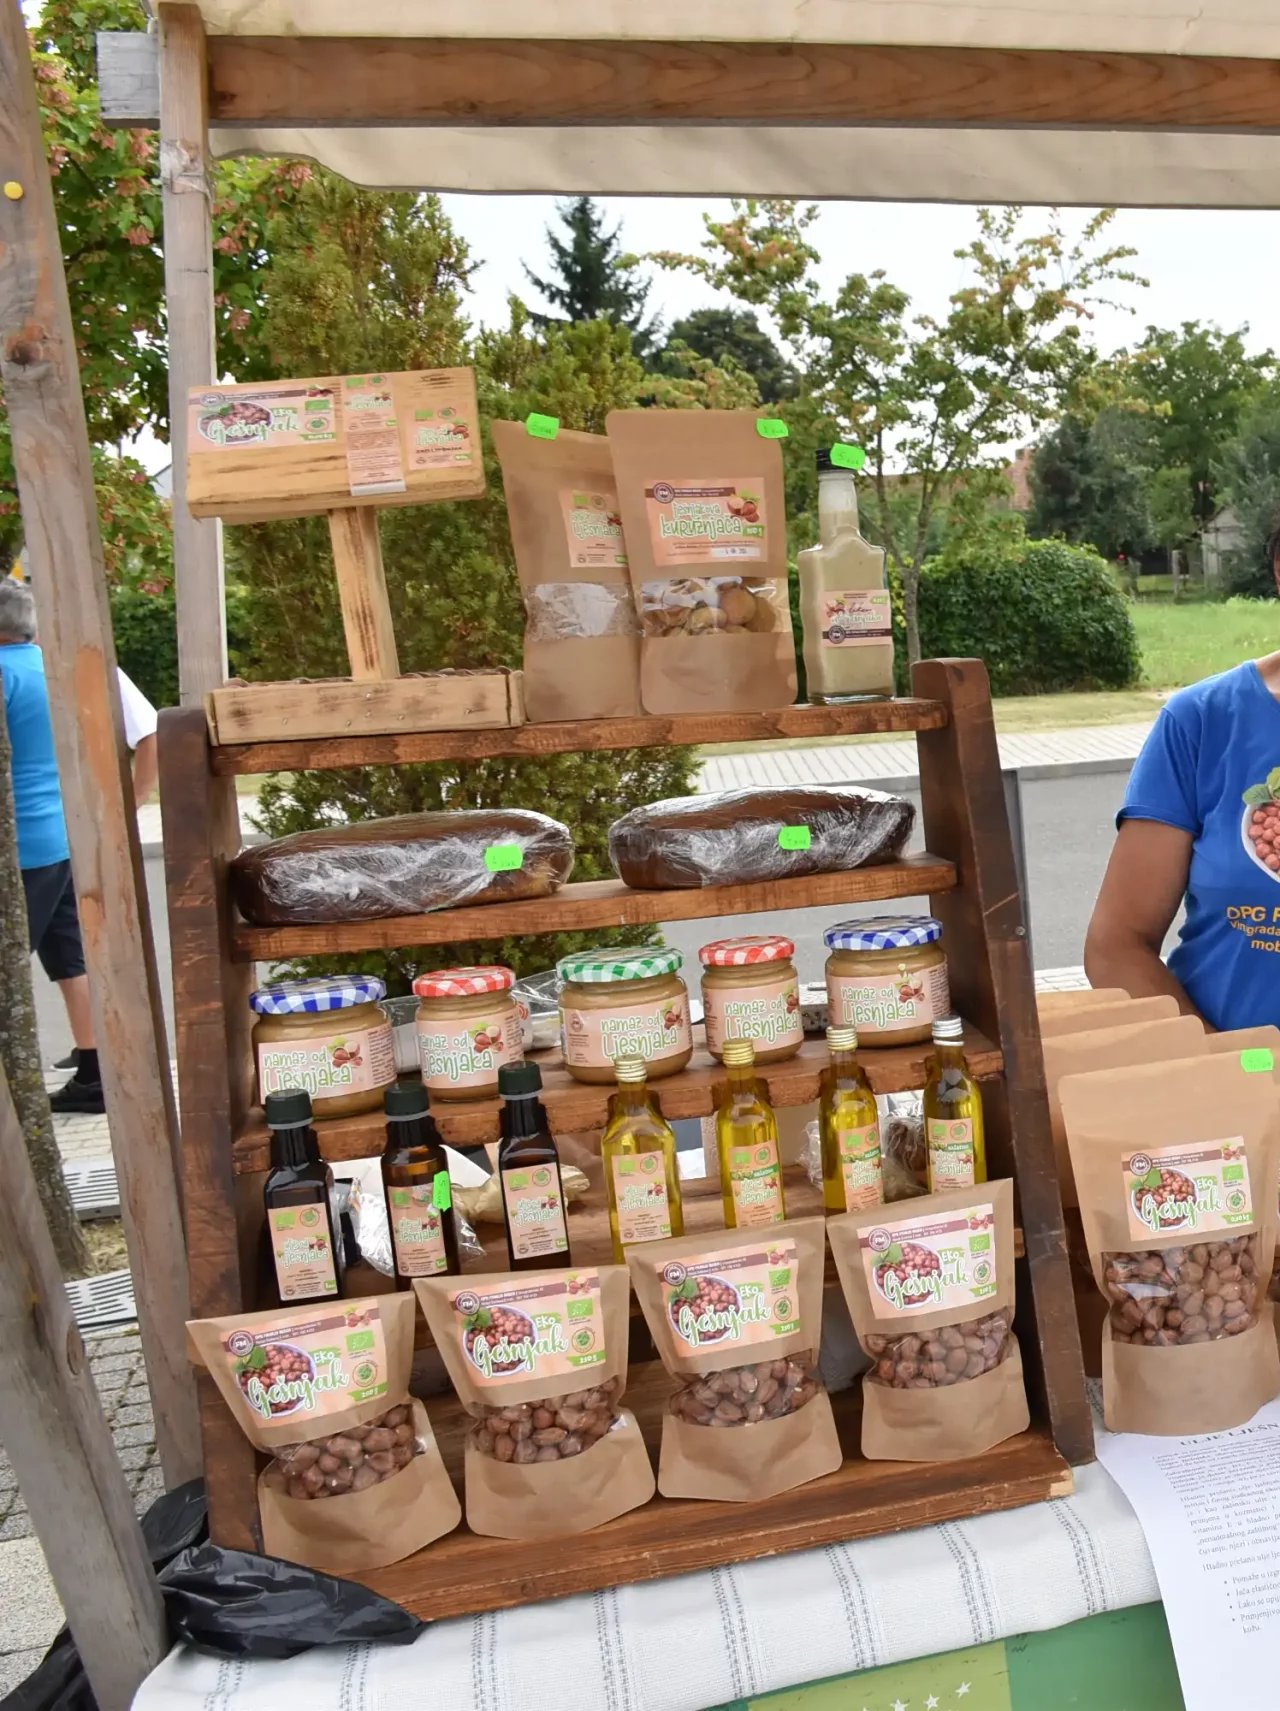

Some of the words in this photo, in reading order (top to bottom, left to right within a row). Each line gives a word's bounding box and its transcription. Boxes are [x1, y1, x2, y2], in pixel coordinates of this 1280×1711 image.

[842, 987, 877, 1000] namaz
[881, 983, 895, 999] od
[725, 1001, 766, 1016] namaz
[771, 998, 785, 1011] od
[601, 1018, 643, 1033] namaz
[647, 1012, 661, 1027] od
[453, 1031, 469, 1047] od
[264, 1051, 307, 1068] namaz
[312, 1047, 328, 1063] od
[1197, 1179, 1214, 1189] EKO
[941, 1251, 960, 1262] EKO
[740, 1285, 759, 1297] EKO
[537, 1316, 556, 1328] EKO
[315, 1351, 335, 1364] EKO
